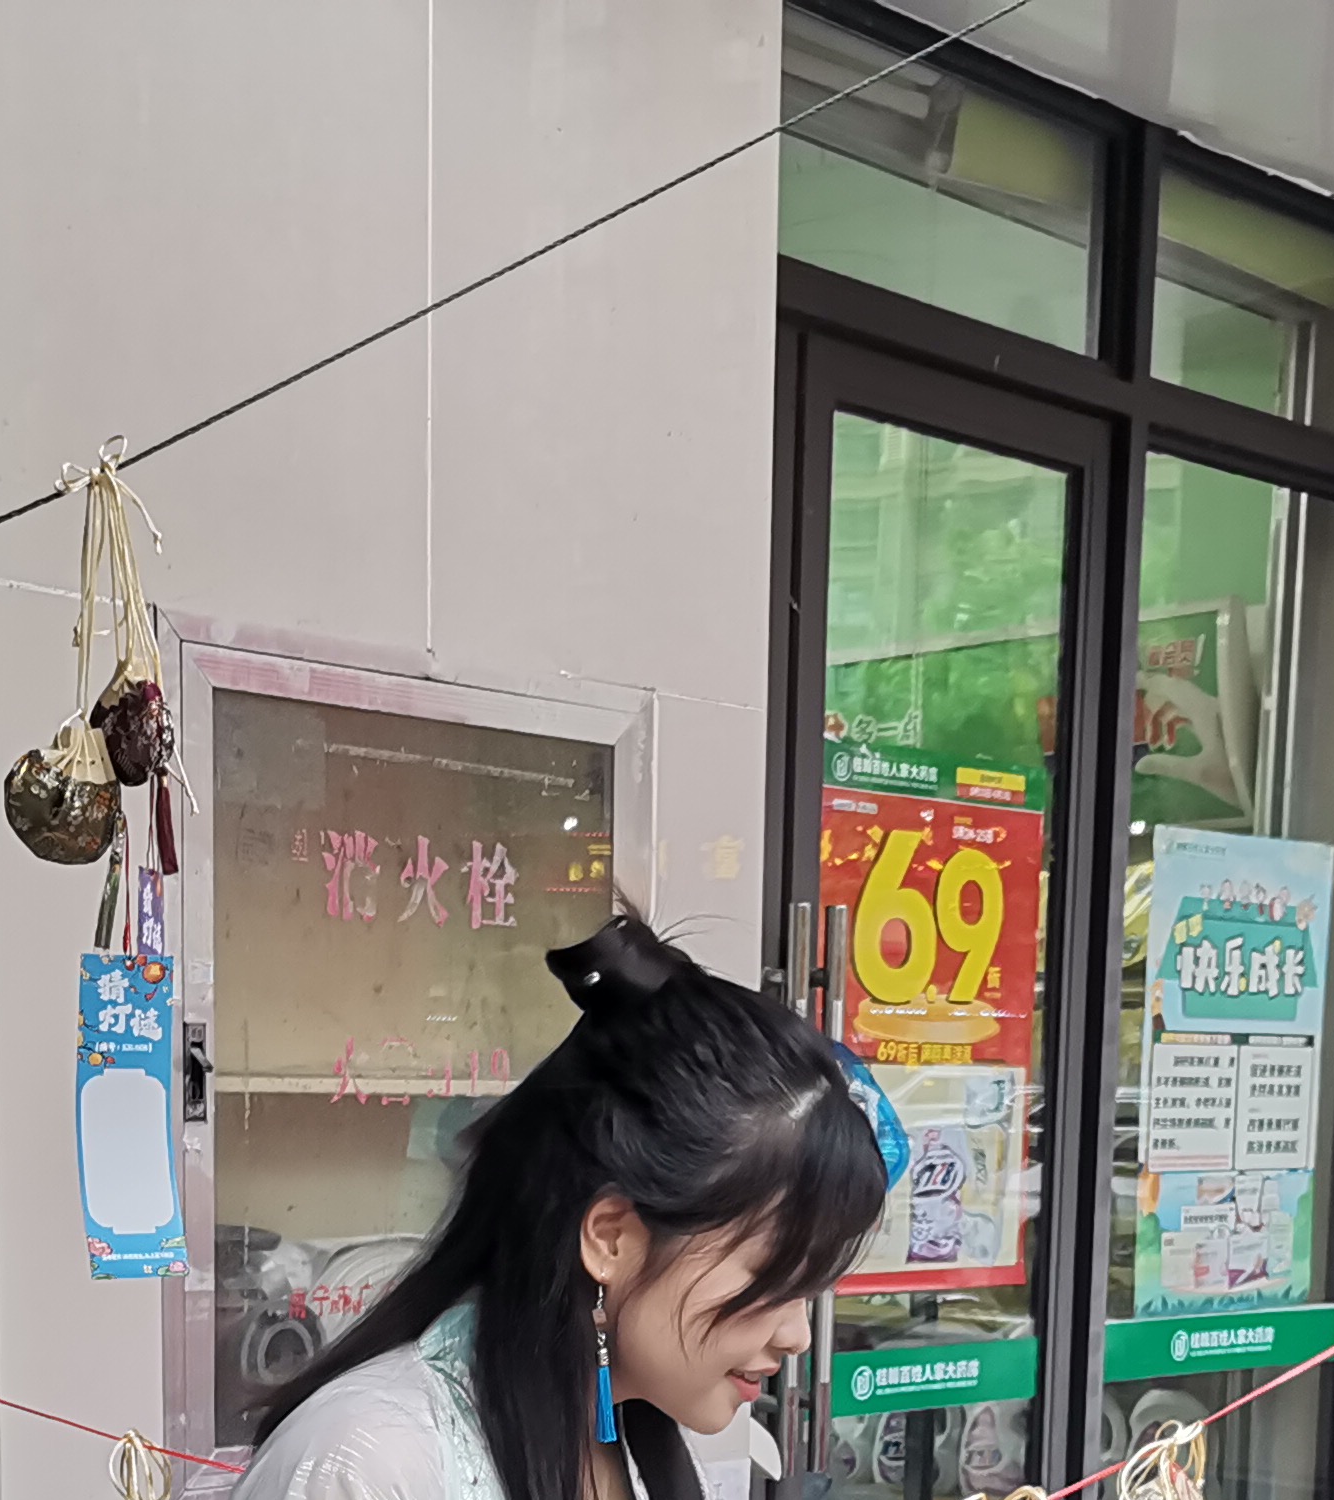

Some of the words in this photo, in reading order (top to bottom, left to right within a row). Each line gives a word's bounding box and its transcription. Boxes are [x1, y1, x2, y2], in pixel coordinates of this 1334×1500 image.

[321, 830, 518, 929] 消火栓
[97, 969, 130, 1003] 猜
[1177, 937, 1305, 998] 快乐成长
[98, 1004, 163, 1042] 灯谜
